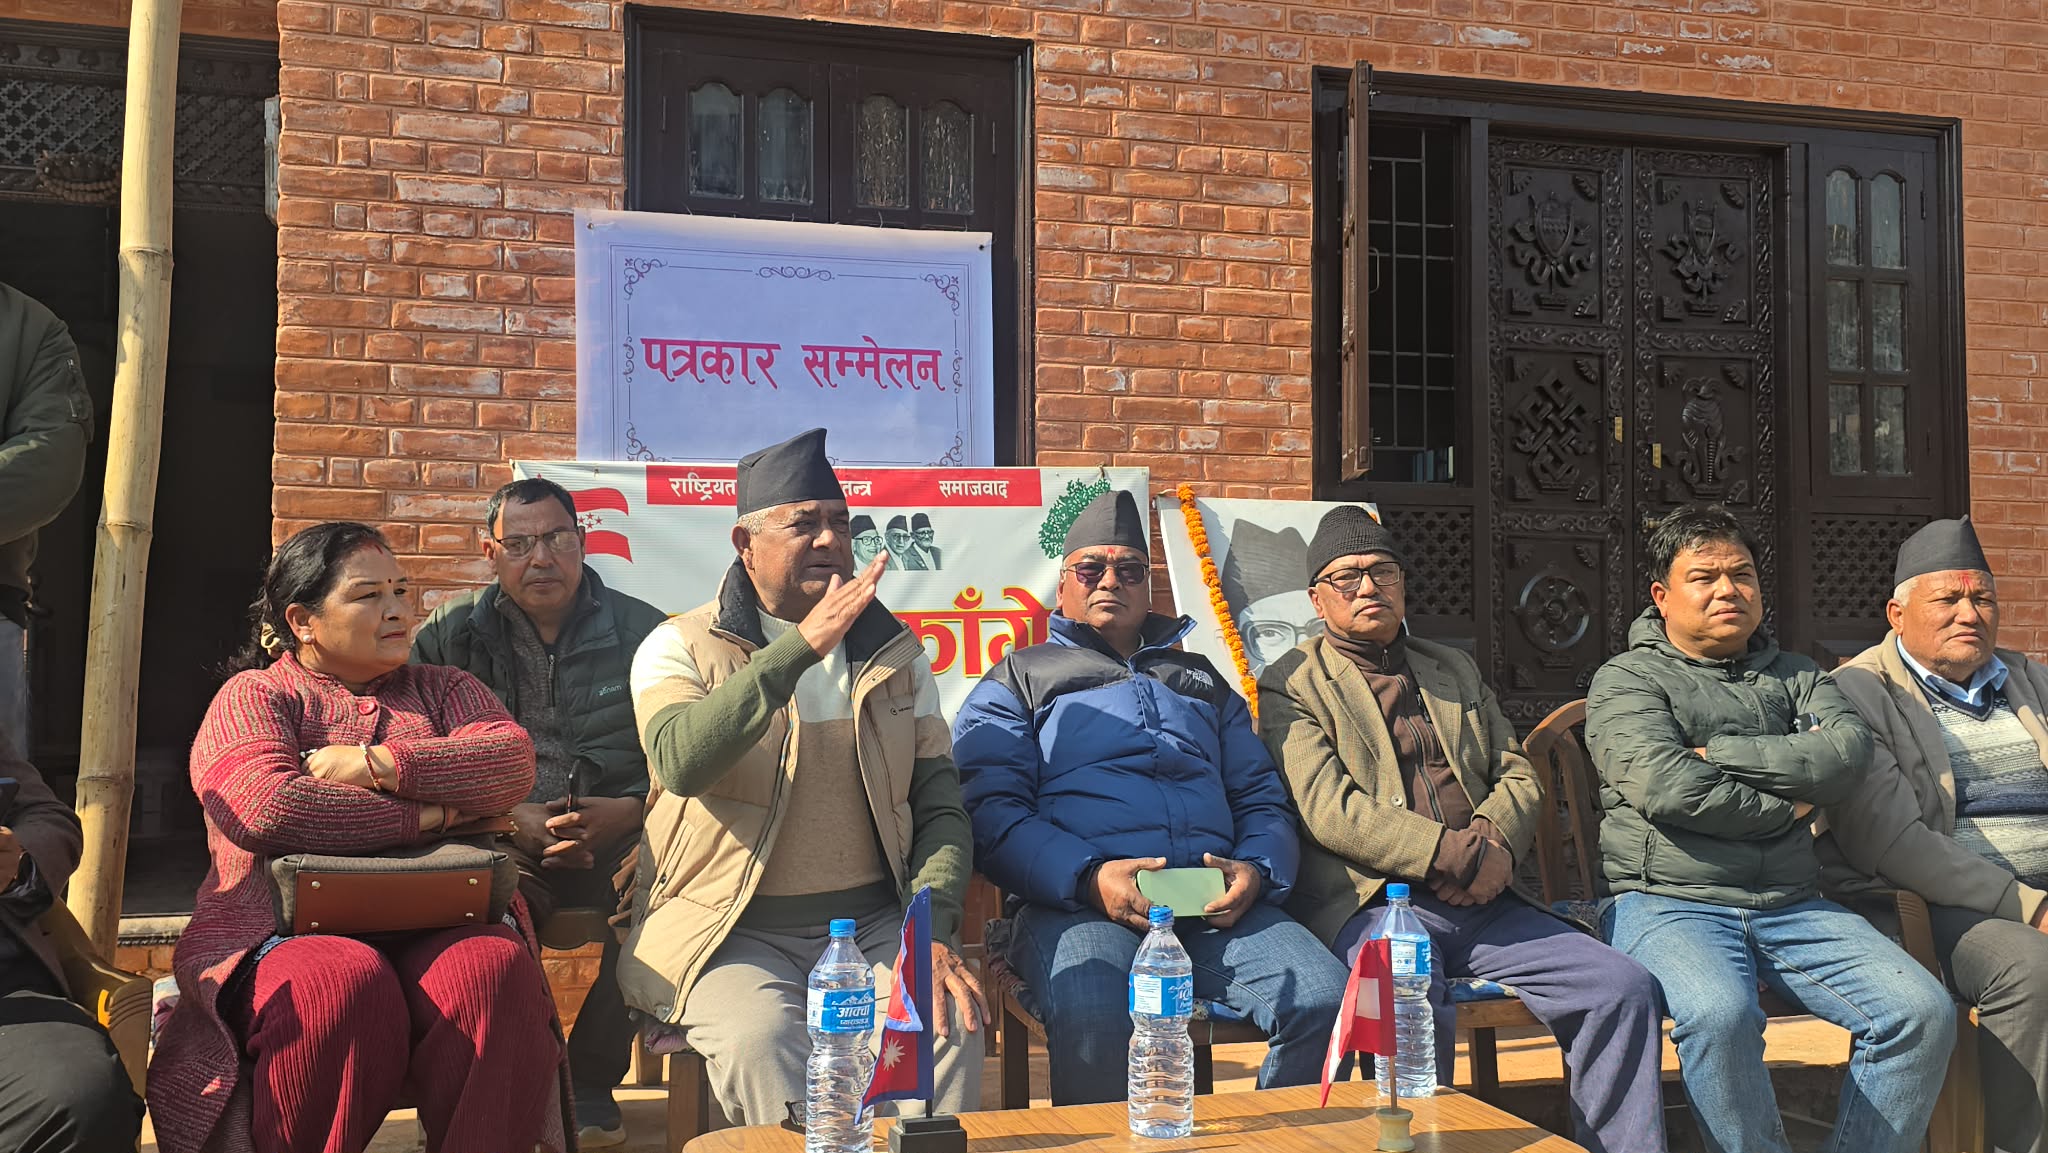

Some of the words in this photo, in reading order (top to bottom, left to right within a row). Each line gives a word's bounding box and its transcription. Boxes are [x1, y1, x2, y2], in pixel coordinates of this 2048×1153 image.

[640, 338, 781, 390] पत्रकार
[801, 335, 947, 392] सम्मेलन
[668, 472, 738, 501] राष्ट्रियत
[839, 480, 872, 497] तन्त्र
[938, 480, 1009, 498] समाजवाद
